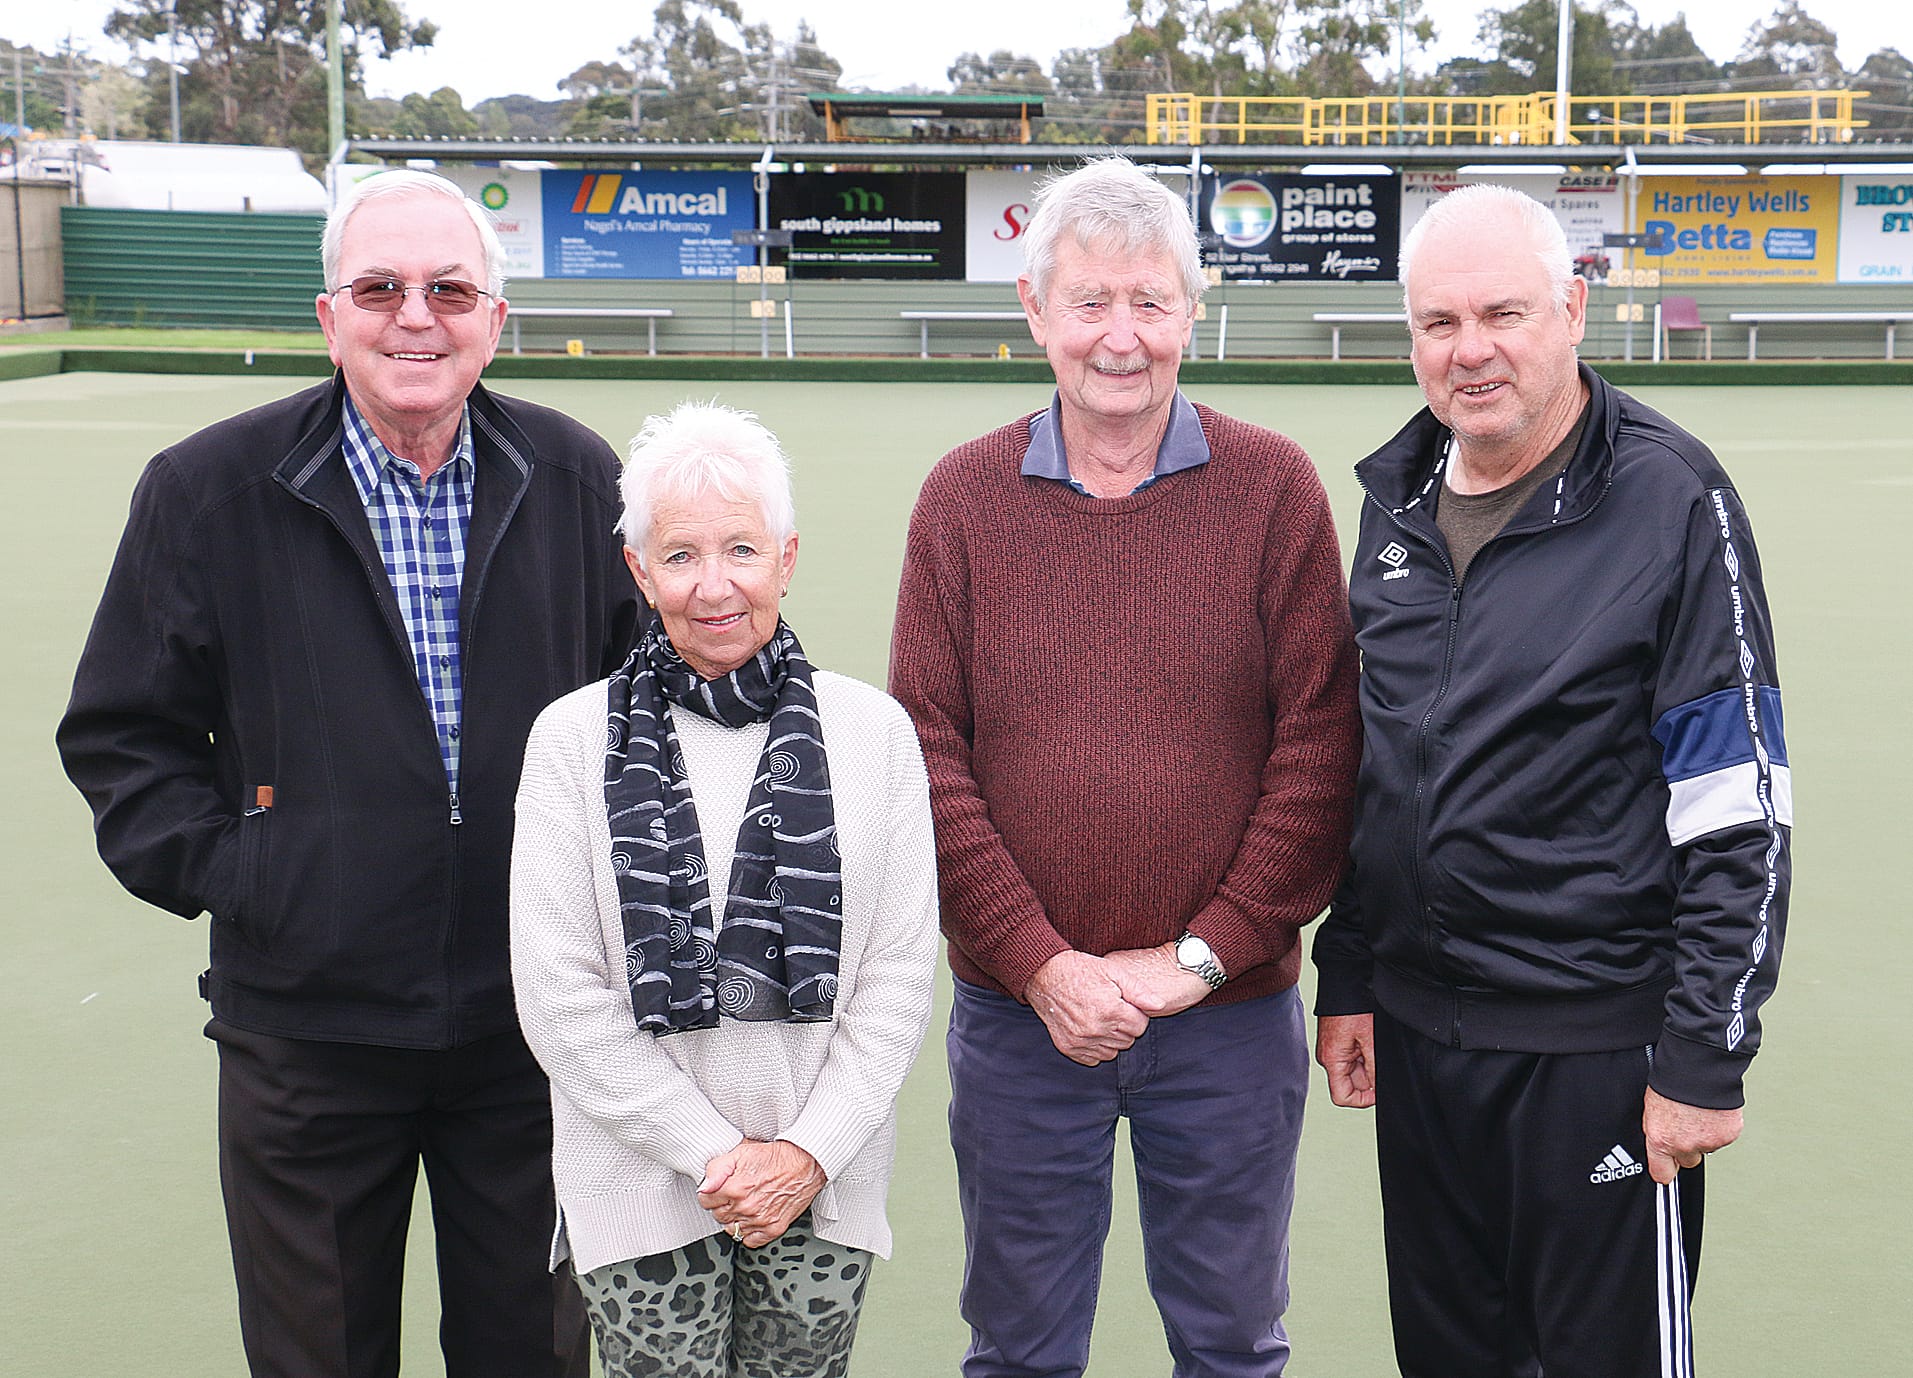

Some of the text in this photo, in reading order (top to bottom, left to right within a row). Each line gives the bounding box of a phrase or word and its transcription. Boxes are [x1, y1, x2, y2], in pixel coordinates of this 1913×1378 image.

[1560, 176, 1602, 186] CASE
[618, 186, 728, 216] Amcal
[1282, 183, 1373, 209] paint
[1561, 198, 1600, 210] Spares
[1653, 191, 1811, 218] Hartley Wells
[1855, 184, 1913, 206] BRO
[624, 219, 658, 232] Amcal
[659, 219, 711, 235] Pharmacy
[780, 216, 941, 234] south gippsland homes
[1282, 205, 1377, 232] place
[1882, 211, 1913, 233] ST
[1281, 232, 1376, 244] group of stores
[1645, 220, 1752, 257] Betta
[1859, 265, 1903, 276] GRAIN
[1711, 489, 1730, 539] umbro
[1382, 567, 1410, 581] umbro
[1730, 584, 1744, 637] umbro
[1744, 682, 1758, 733] umbro
[1760, 779, 1775, 828] umbro
[1758, 872, 1777, 922] umbro
[1731, 966, 1757, 1012] umbro
[1589, 1162, 1644, 1184] adidas
